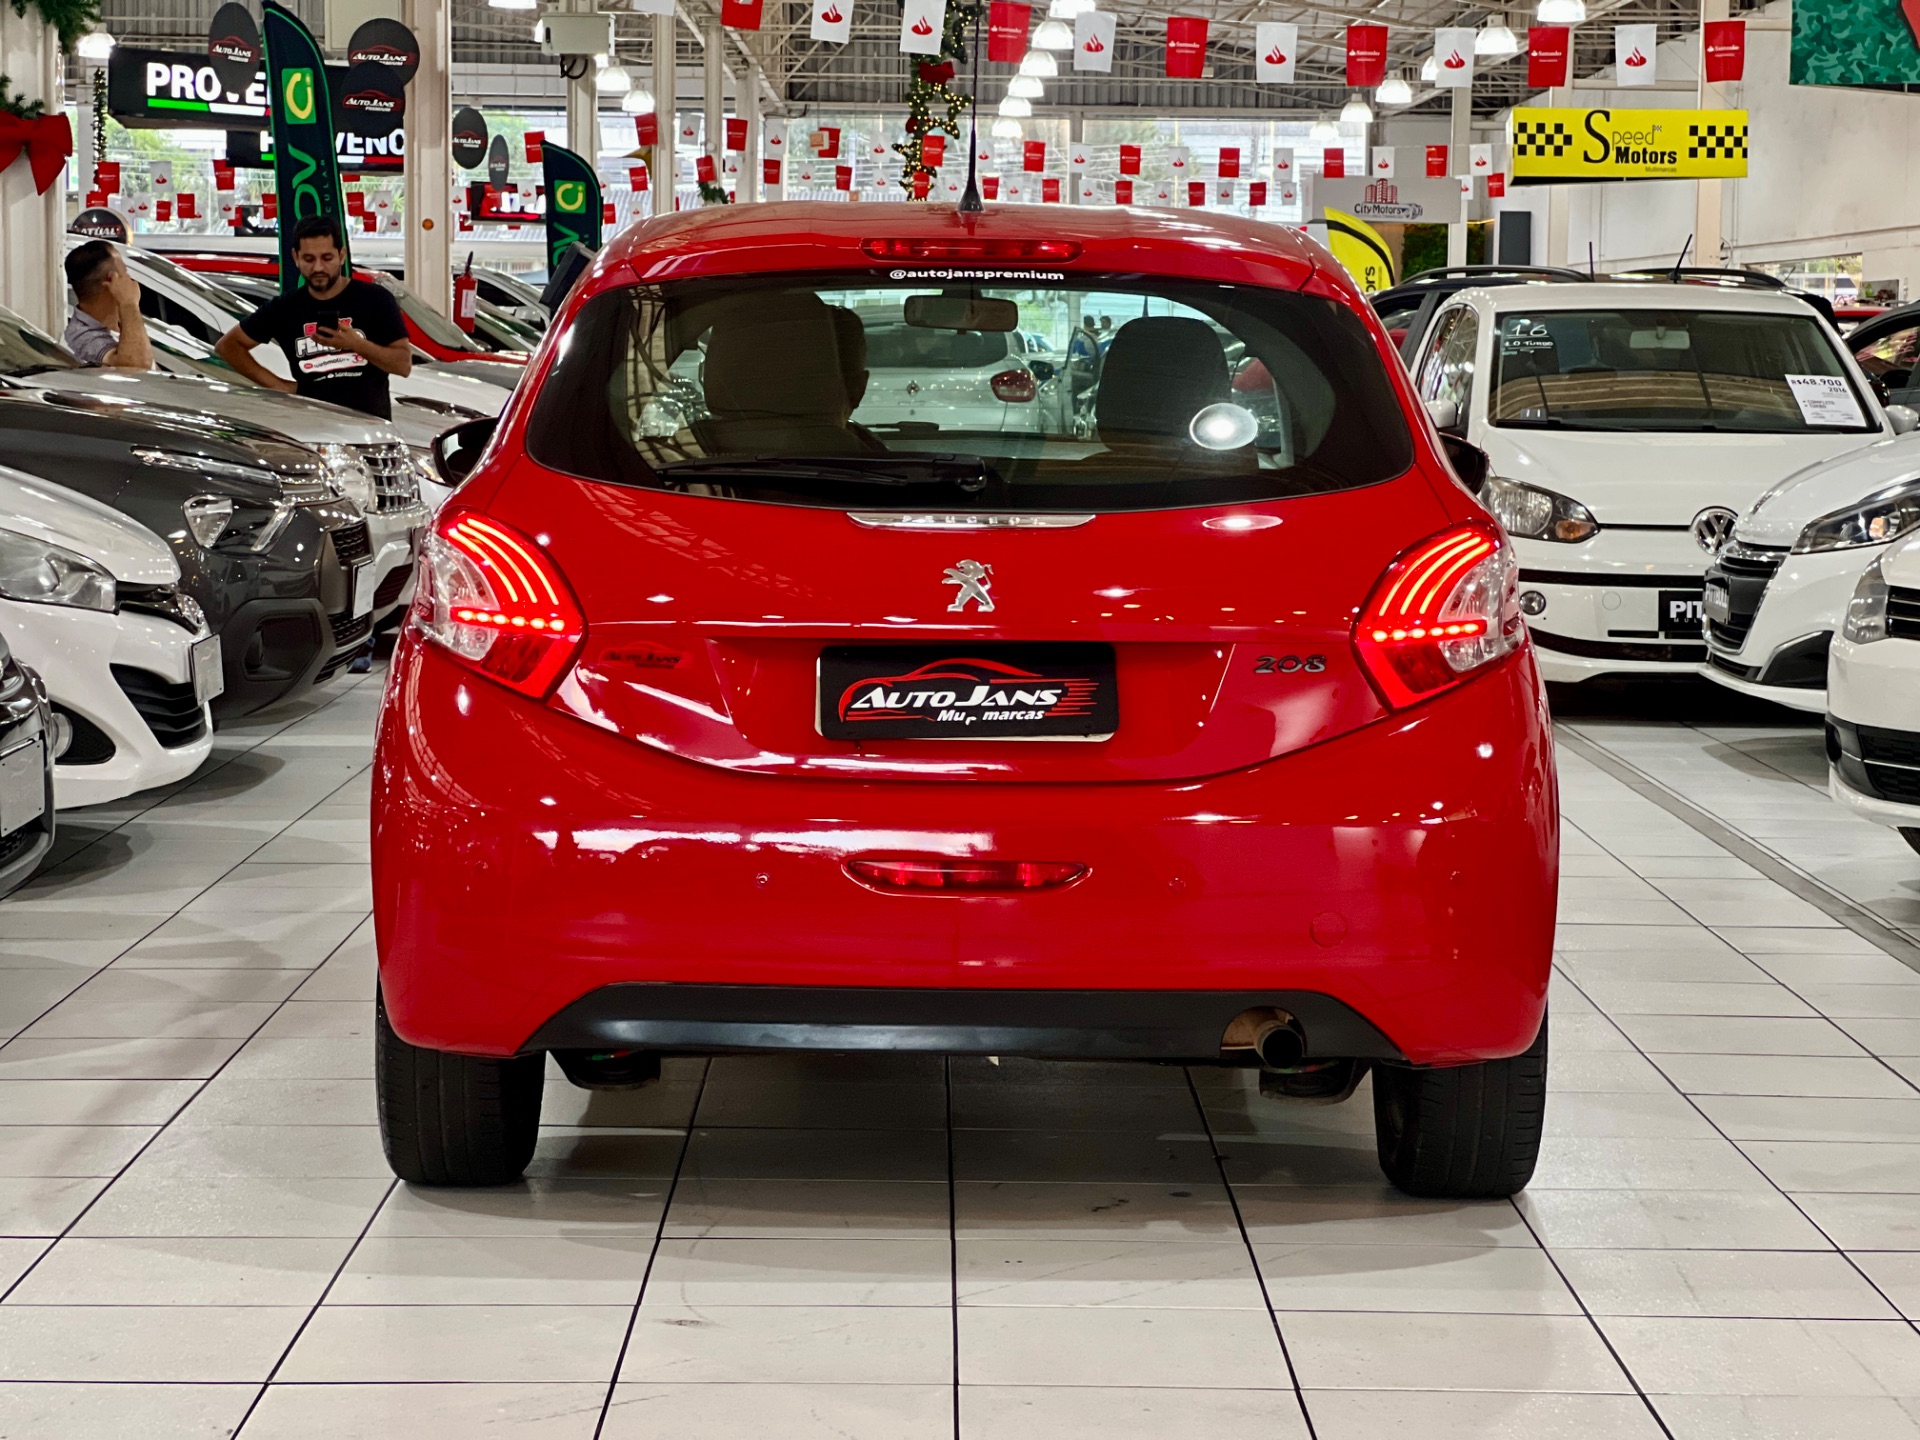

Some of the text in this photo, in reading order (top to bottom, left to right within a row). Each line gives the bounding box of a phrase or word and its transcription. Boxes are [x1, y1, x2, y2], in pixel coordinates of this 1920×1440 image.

[1583, 109, 1656, 164] Speed
[1615, 146, 1678, 165] Motors
[1354, 203, 1402, 215] City Motors
[889, 269, 1065, 281] @autojanspremium
[1365, 265, 1376, 293] ors
[1669, 600, 1703, 619] PIT
[1253, 654, 1328, 674] 208
